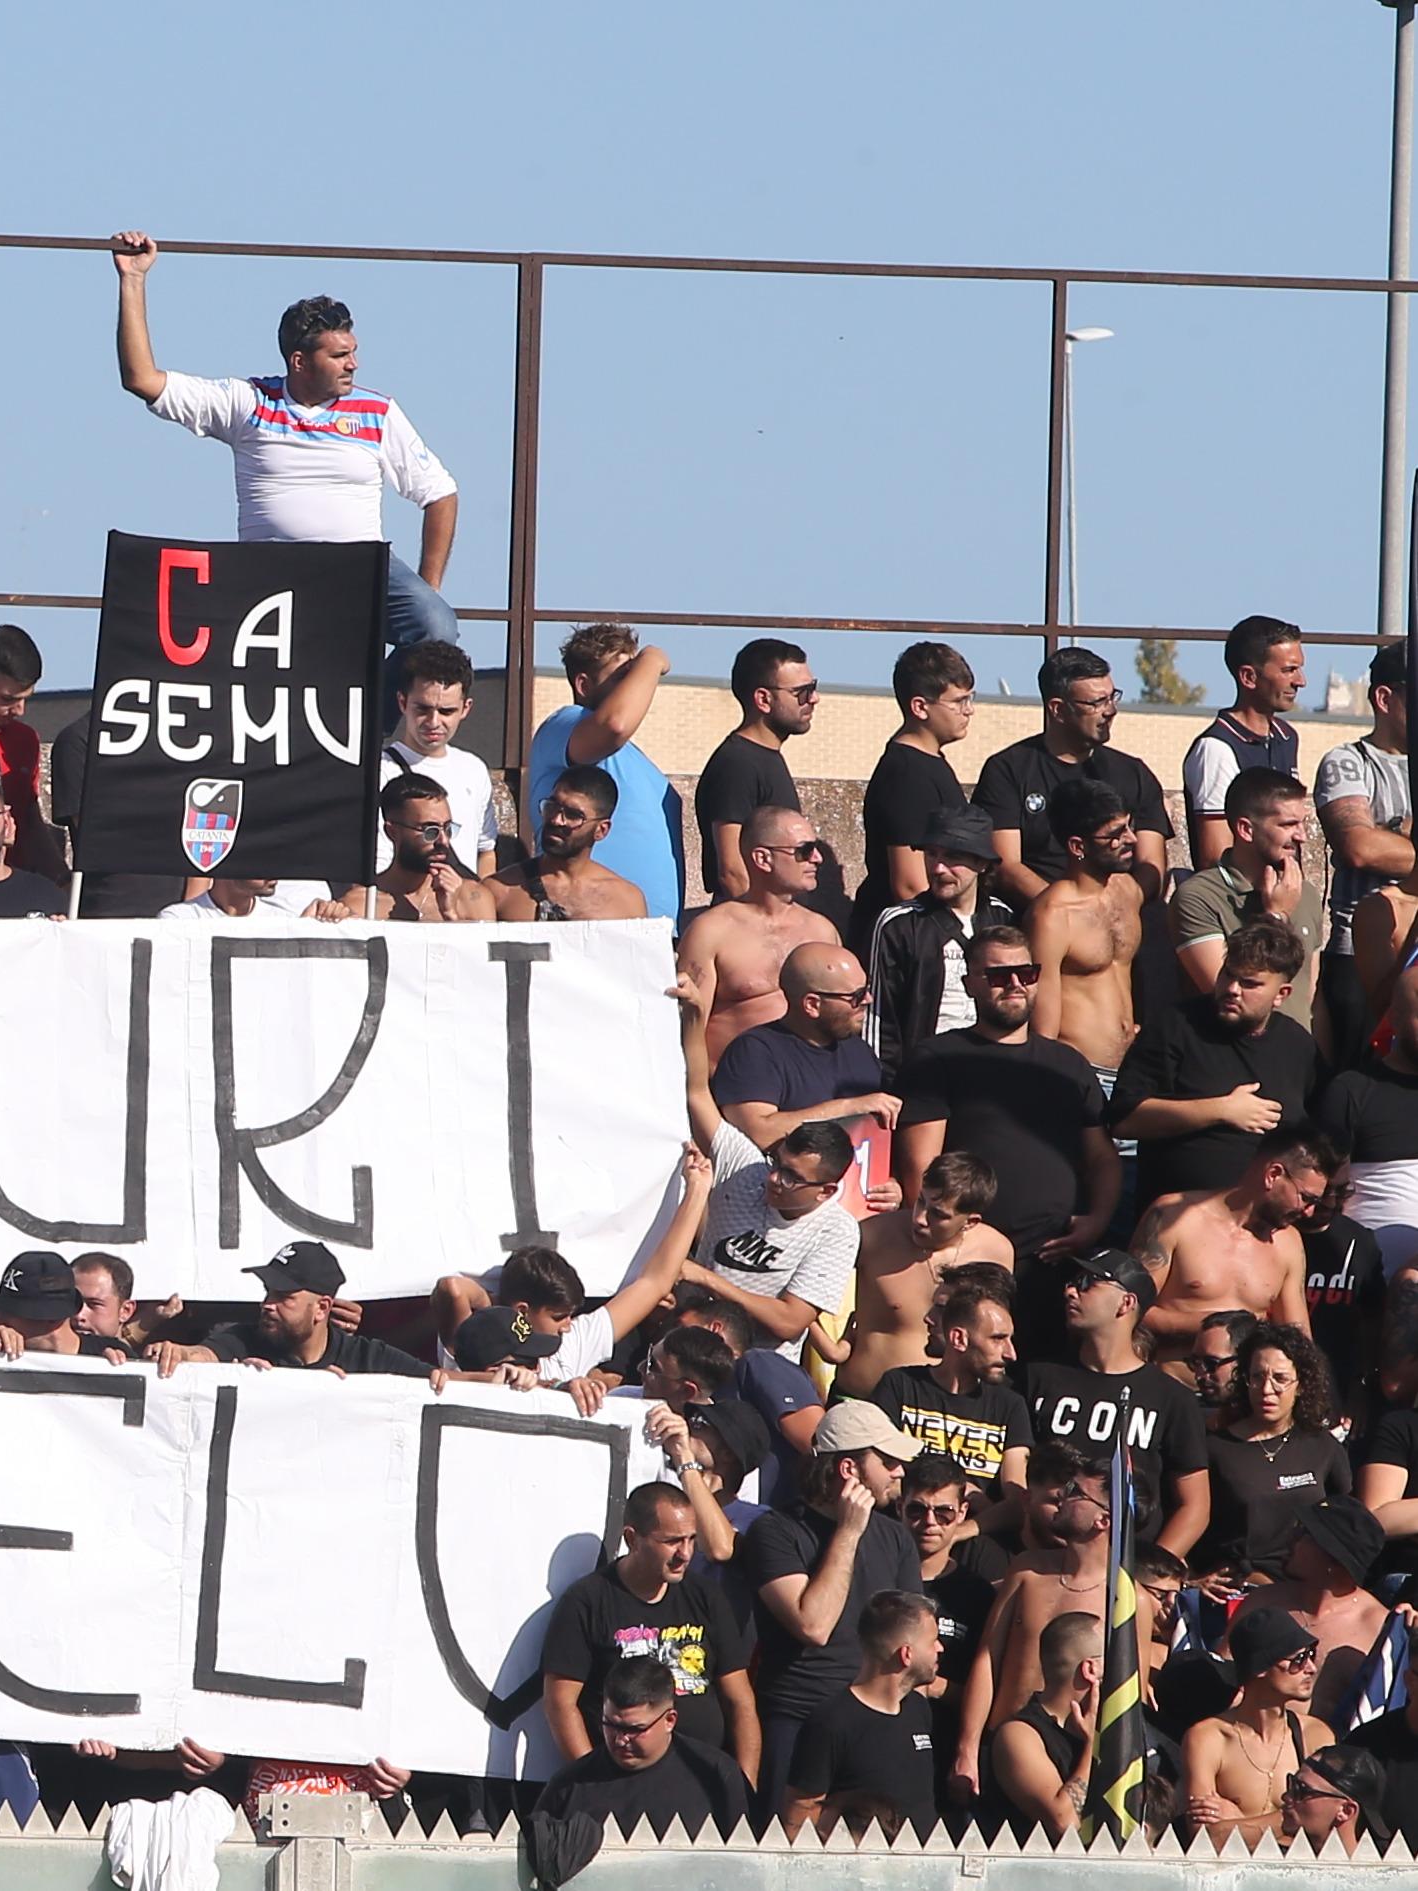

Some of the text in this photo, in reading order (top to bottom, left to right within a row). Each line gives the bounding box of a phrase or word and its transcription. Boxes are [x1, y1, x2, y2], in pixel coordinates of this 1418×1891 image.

[1323, 758, 1361, 787] 99
[188, 829, 231, 841] CATANIA
[731, 1230, 784, 1270] NIKE
[902, 1409, 1006, 1455] NEVER
